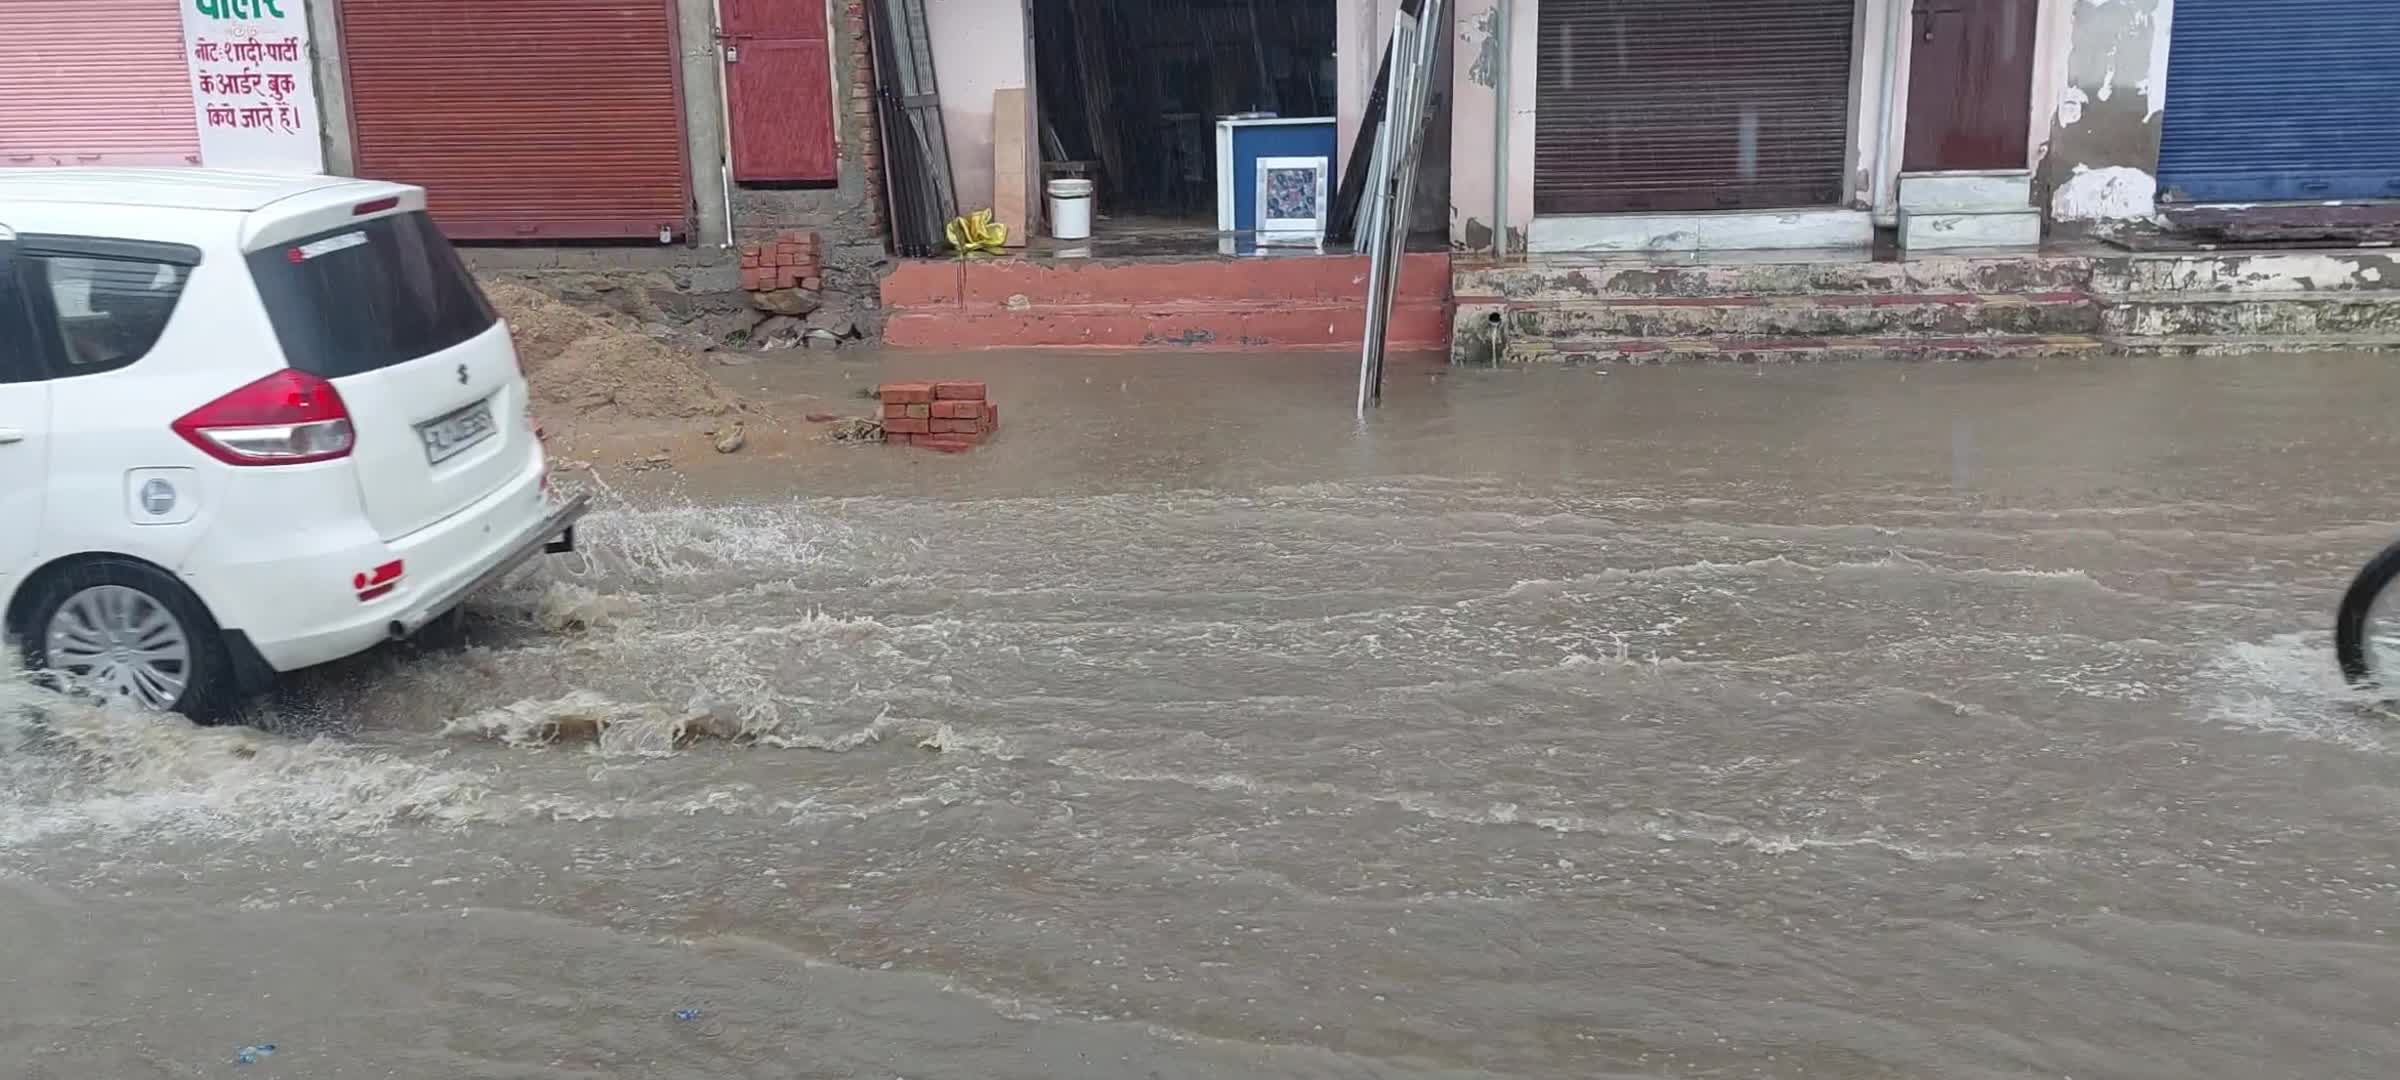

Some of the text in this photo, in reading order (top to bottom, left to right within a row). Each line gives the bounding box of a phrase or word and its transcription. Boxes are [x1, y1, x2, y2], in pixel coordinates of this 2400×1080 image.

[200, 67, 296, 101] के आर्डर बुक
[239, 101, 274, 133] जाते
